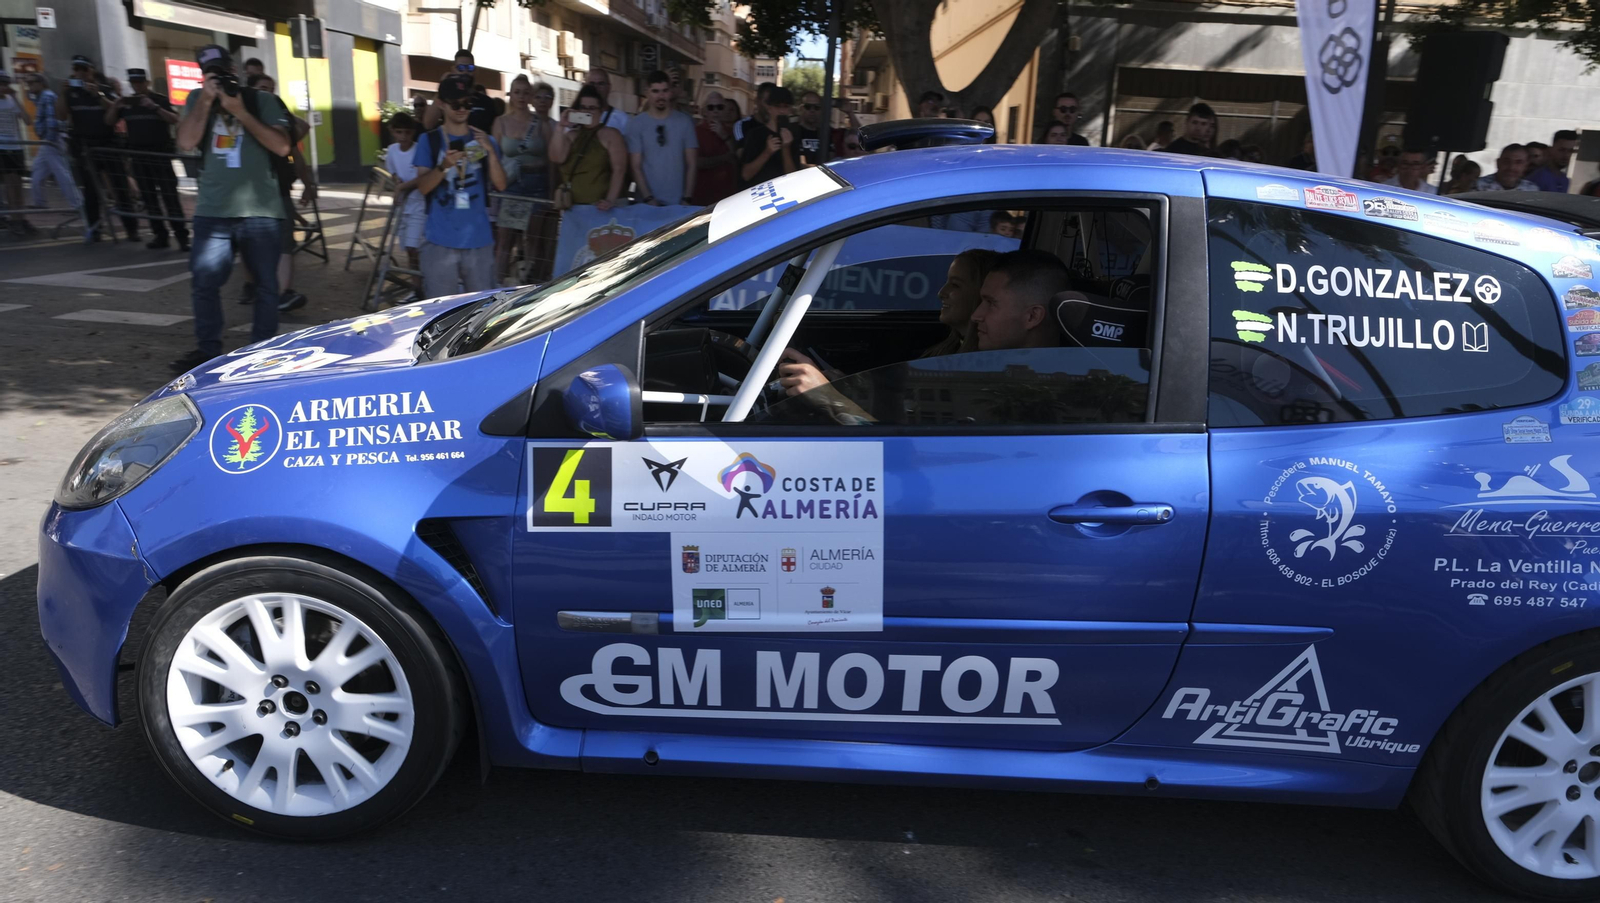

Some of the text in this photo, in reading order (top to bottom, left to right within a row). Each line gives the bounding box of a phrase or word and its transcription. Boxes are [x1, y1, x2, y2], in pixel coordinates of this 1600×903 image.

[1276, 263, 1472, 303] D.GONZALEZ
[1092, 322, 1124, 339] OMP
[1277, 311, 1455, 351] N.TRUJILLO
[287, 390, 434, 424] ARMERIA
[285, 419, 463, 451] EL PINSAPAR
[283, 451, 465, 468] CAZA Y PESCA Tel. 956 461 664
[543, 449, 596, 525] 4
[781, 477, 876, 493] COSTA DE
[1308, 456, 1360, 474] MANUEL
[1362, 469, 1397, 514] TAMAYO
[623, 502, 706, 511] CUPRA
[761, 493, 879, 520] ALMERÍA
[632, 513, 697, 521] INDALO MOTOR
[705, 553, 769, 563] DIPUTACIÓN
[809, 546, 875, 561] ALMERÍA
[705, 563, 766, 573] DE ALMERÍA
[809, 562, 843, 570] CIUDAD
[1266, 548, 1281, 566] 608
[1278, 564, 1295, 579] 458
[1294, 573, 1313, 587] 902
[1321, 578, 1335, 588] EL
[1337, 557, 1379, 586] BOSQUE
[1433, 557, 1470, 572] P.L.
[1477, 558, 1502, 573] La
[1508, 559, 1583, 574] Ventilla
[1450, 578, 1496, 589] Prado
[1500, 579, 1523, 590] del
[1528, 580, 1558, 592] Rey
[1493, 595, 1588, 608] 695 487 547
[592, 642, 1060, 715] GM MOTOR
[1162, 687, 1399, 735] ArtiGrafic
[1345, 735, 1421, 754] Ubrique
